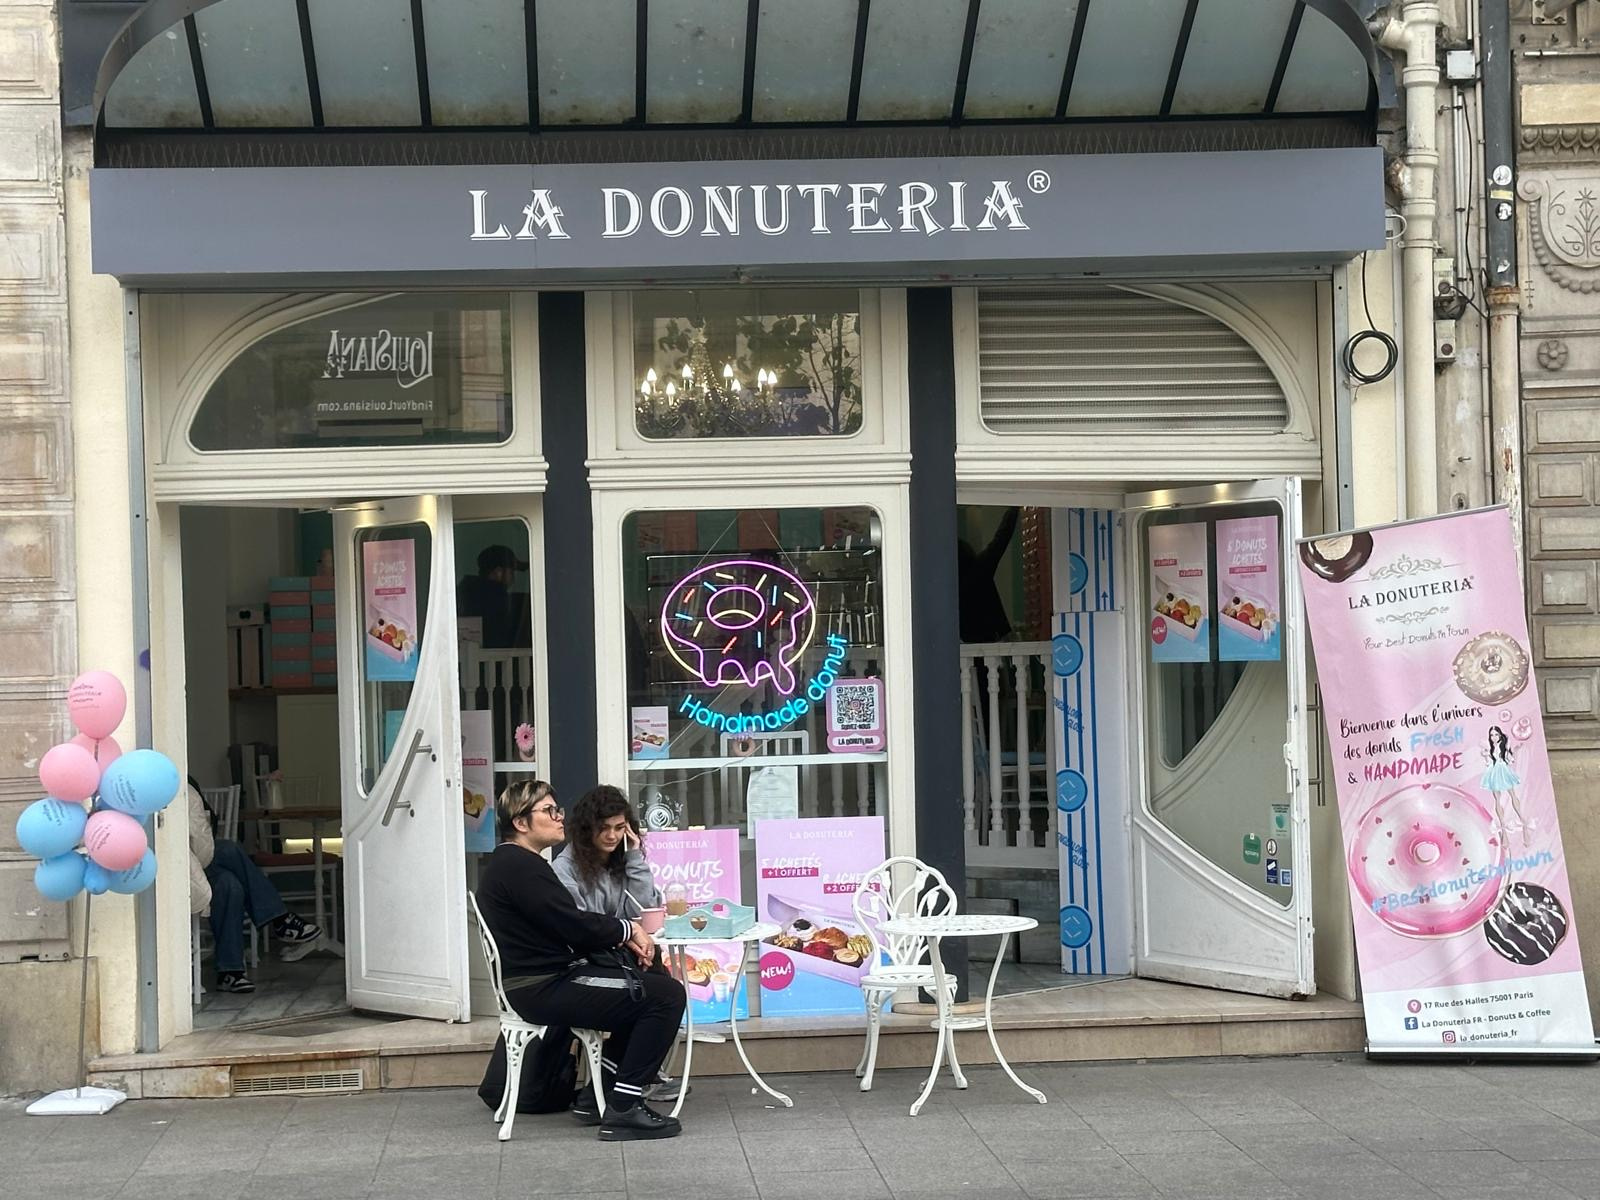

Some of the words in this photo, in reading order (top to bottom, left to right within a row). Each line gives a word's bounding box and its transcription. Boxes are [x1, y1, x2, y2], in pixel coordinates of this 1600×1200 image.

[469, 189, 571, 240] LA
[1348, 594, 1371, 609] LA
[1385, 631, 1405, 648] Best
[679, 693, 809, 734] Handmade
[807, 632, 848, 701] donut
[1340, 718, 1397, 738] Bienvenue
[1400, 713, 1428, 729] dans
[1343, 742, 1361, 760] des
[1365, 737, 1402, 756] donuts
[1347, 772, 1358, 784] &
[1364, 752, 1464, 782] HANDMADE
[761, 962, 792, 979] NEW!
[1434, 1001, 1449, 1009] Rue
[1450, 999, 1464, 1007] des
[1465, 997, 1488, 1005] Halles
[1489, 994, 1512, 1003] 75001
[1514, 991, 1534, 1000] Paris
[1432, 1018, 1471, 1027] Donuteria
[1488, 1013, 1516, 1022] Donuts
[1525, 1009, 1551, 1018] Coffee
